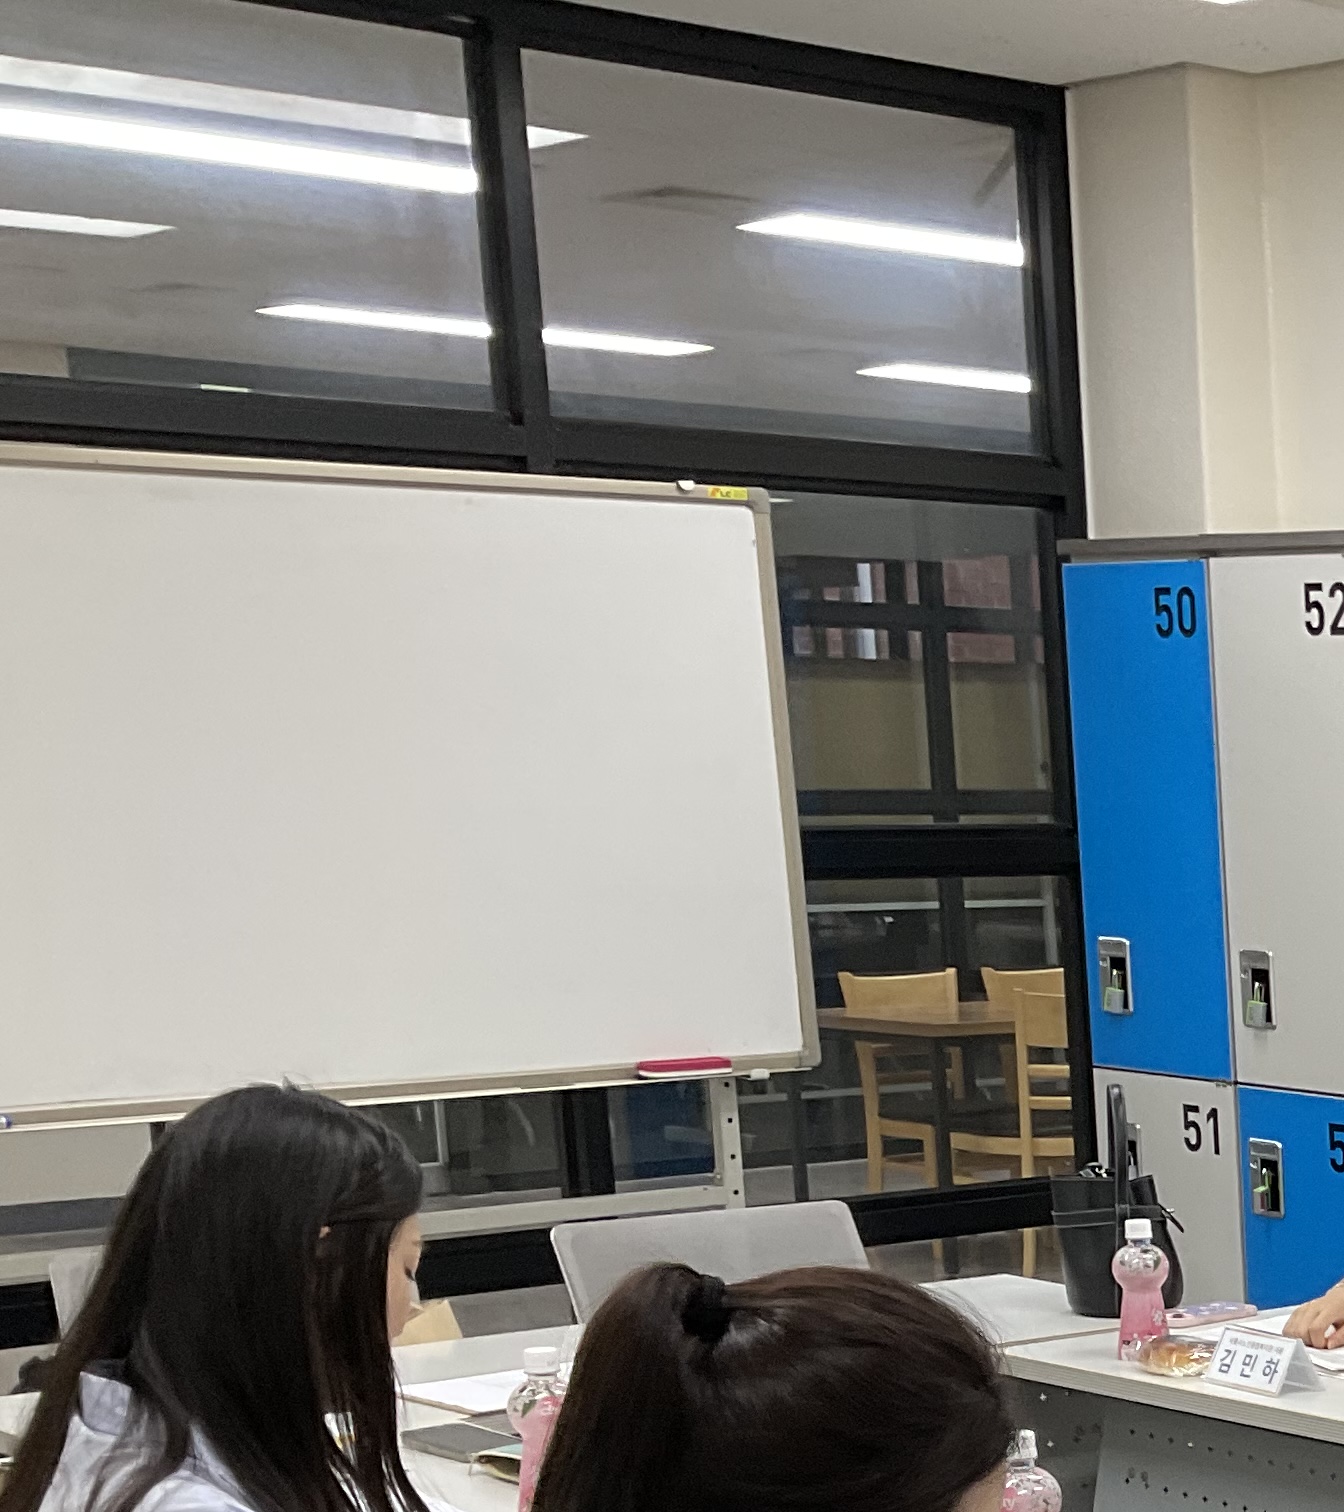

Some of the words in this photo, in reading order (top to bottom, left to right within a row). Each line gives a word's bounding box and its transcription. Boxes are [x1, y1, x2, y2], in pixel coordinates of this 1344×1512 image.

[1153, 587, 1197, 638] 50
[1183, 1104, 1221, 1155] 51
[1218, 1349, 1280, 1384] 김민하
